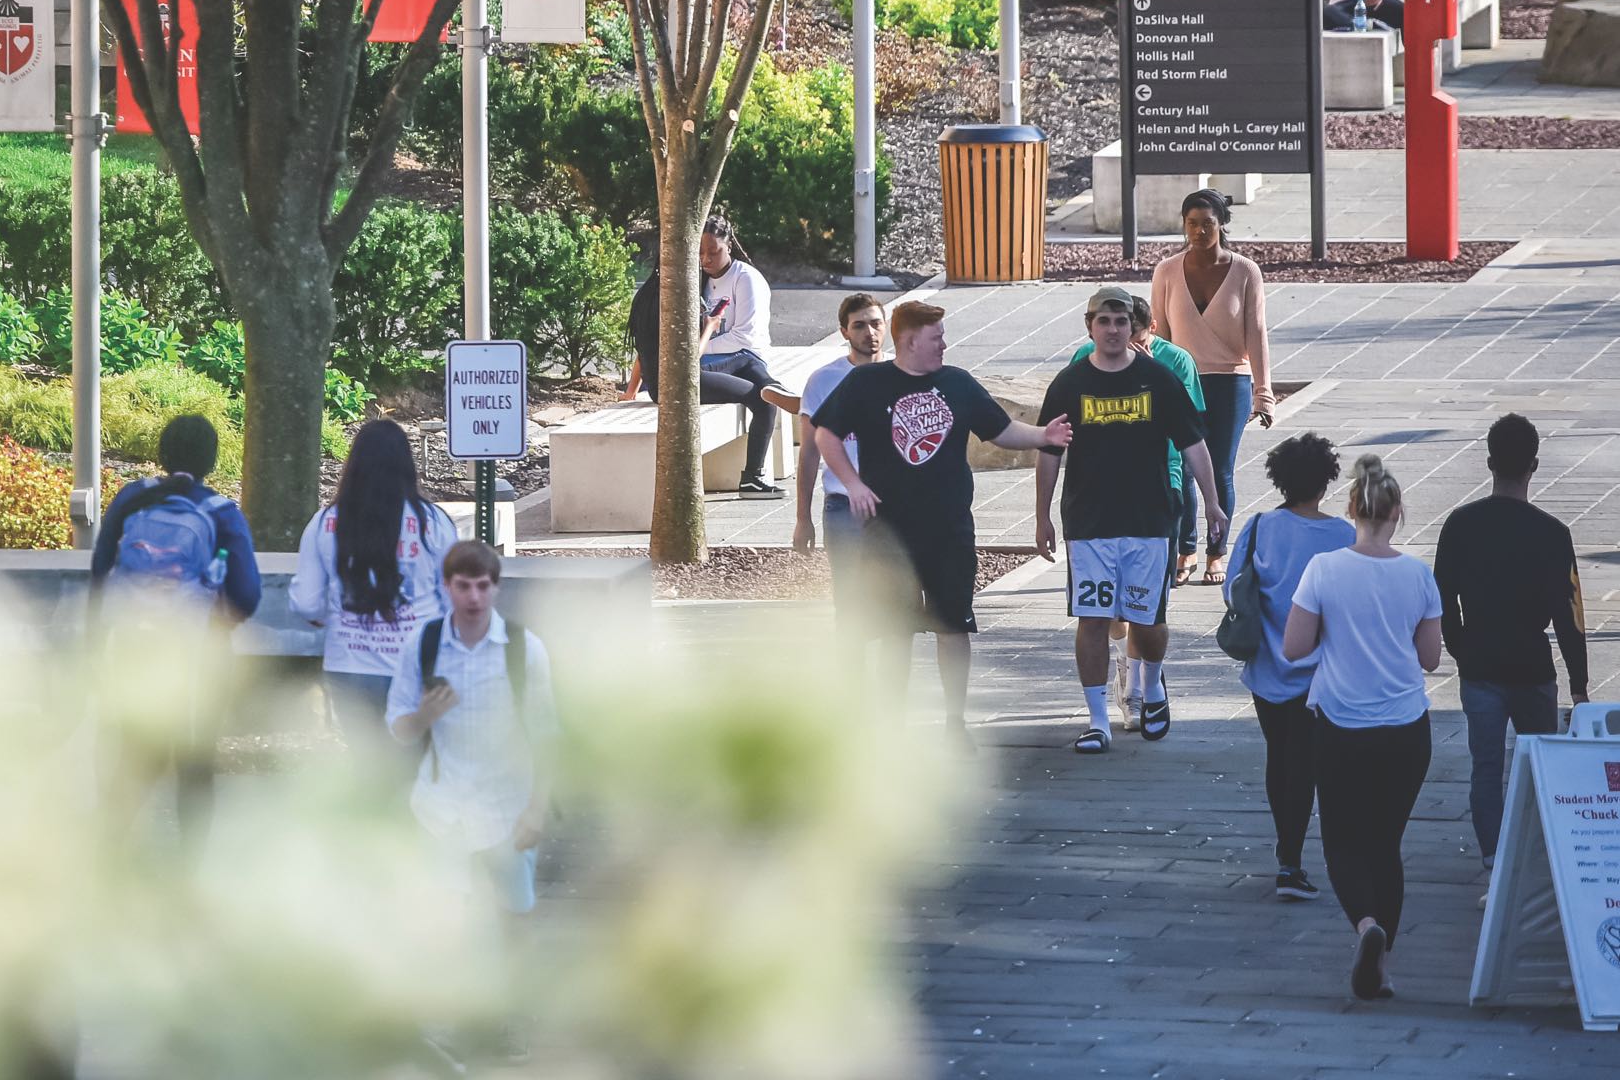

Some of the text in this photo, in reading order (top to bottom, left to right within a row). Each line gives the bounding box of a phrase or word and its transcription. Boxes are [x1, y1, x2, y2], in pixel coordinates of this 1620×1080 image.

[1135, 14, 1204, 25] DaSilva Hall
[1136, 32, 1214, 43] Donovan Hall
[1136, 50, 1194, 61] Hollis Hall
[1137, 68, 1227, 80] Red Storm Field
[1137, 105, 1209, 118] Century Hall
[1137, 122, 1305, 136] Helen and Hugh L. Carey Hall
[1138, 140, 1301, 152] John Cardinal O'Connor Hall
[453, 370, 519, 385] AUTHORIZED
[461, 395, 512, 410] VEHICLES
[1084, 394, 1149, 420] ADELPHI
[915, 410, 944, 431] Shot
[472, 420, 500, 435] ONLY
[1078, 580, 1114, 608] 26
[1554, 794, 1620, 805] Student Mov
